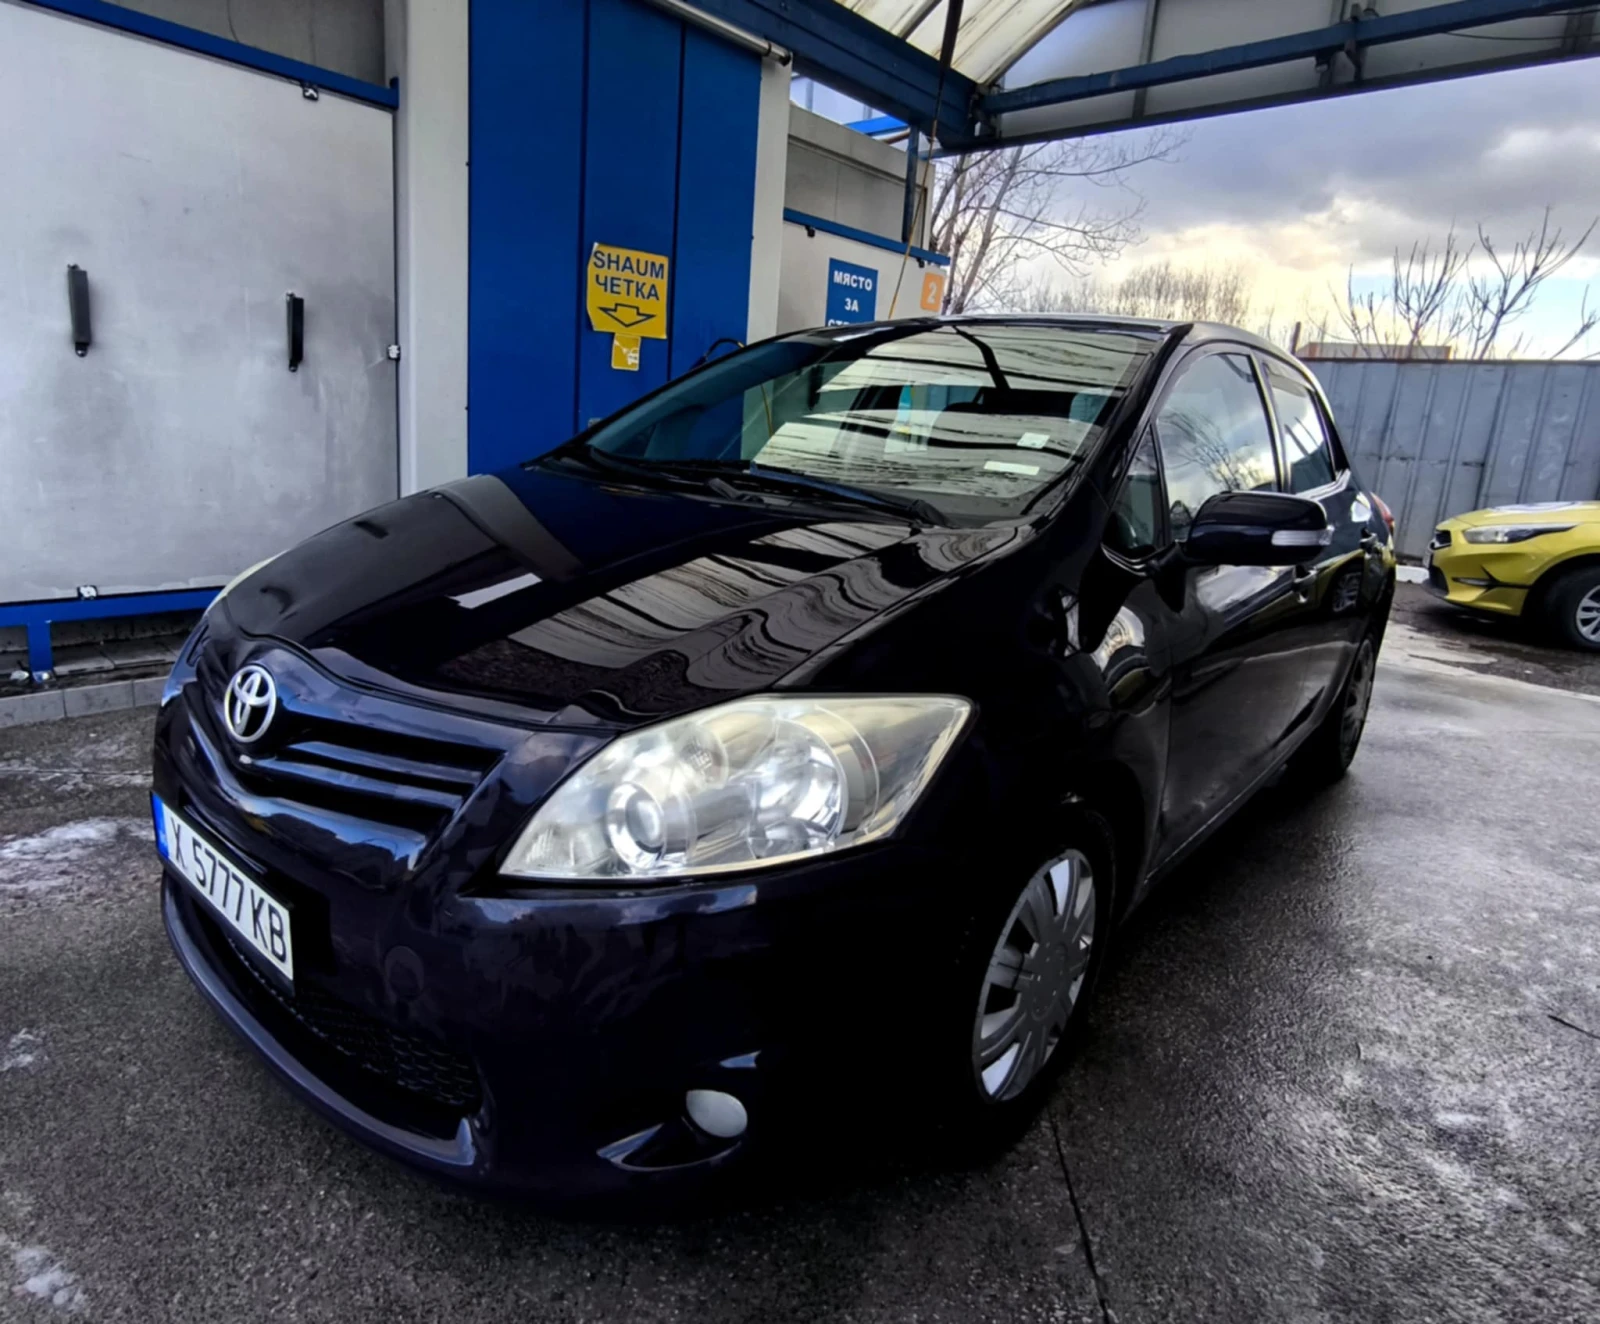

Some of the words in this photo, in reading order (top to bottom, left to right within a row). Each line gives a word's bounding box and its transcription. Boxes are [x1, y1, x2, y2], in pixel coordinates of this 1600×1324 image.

[593, 250, 665, 280] SHAUM
[595, 274, 660, 301] ЧЕТКА
[833, 270, 873, 292] МЯСТО
[926, 281, 938, 304] 2
[844, 298, 859, 313] ЗА
